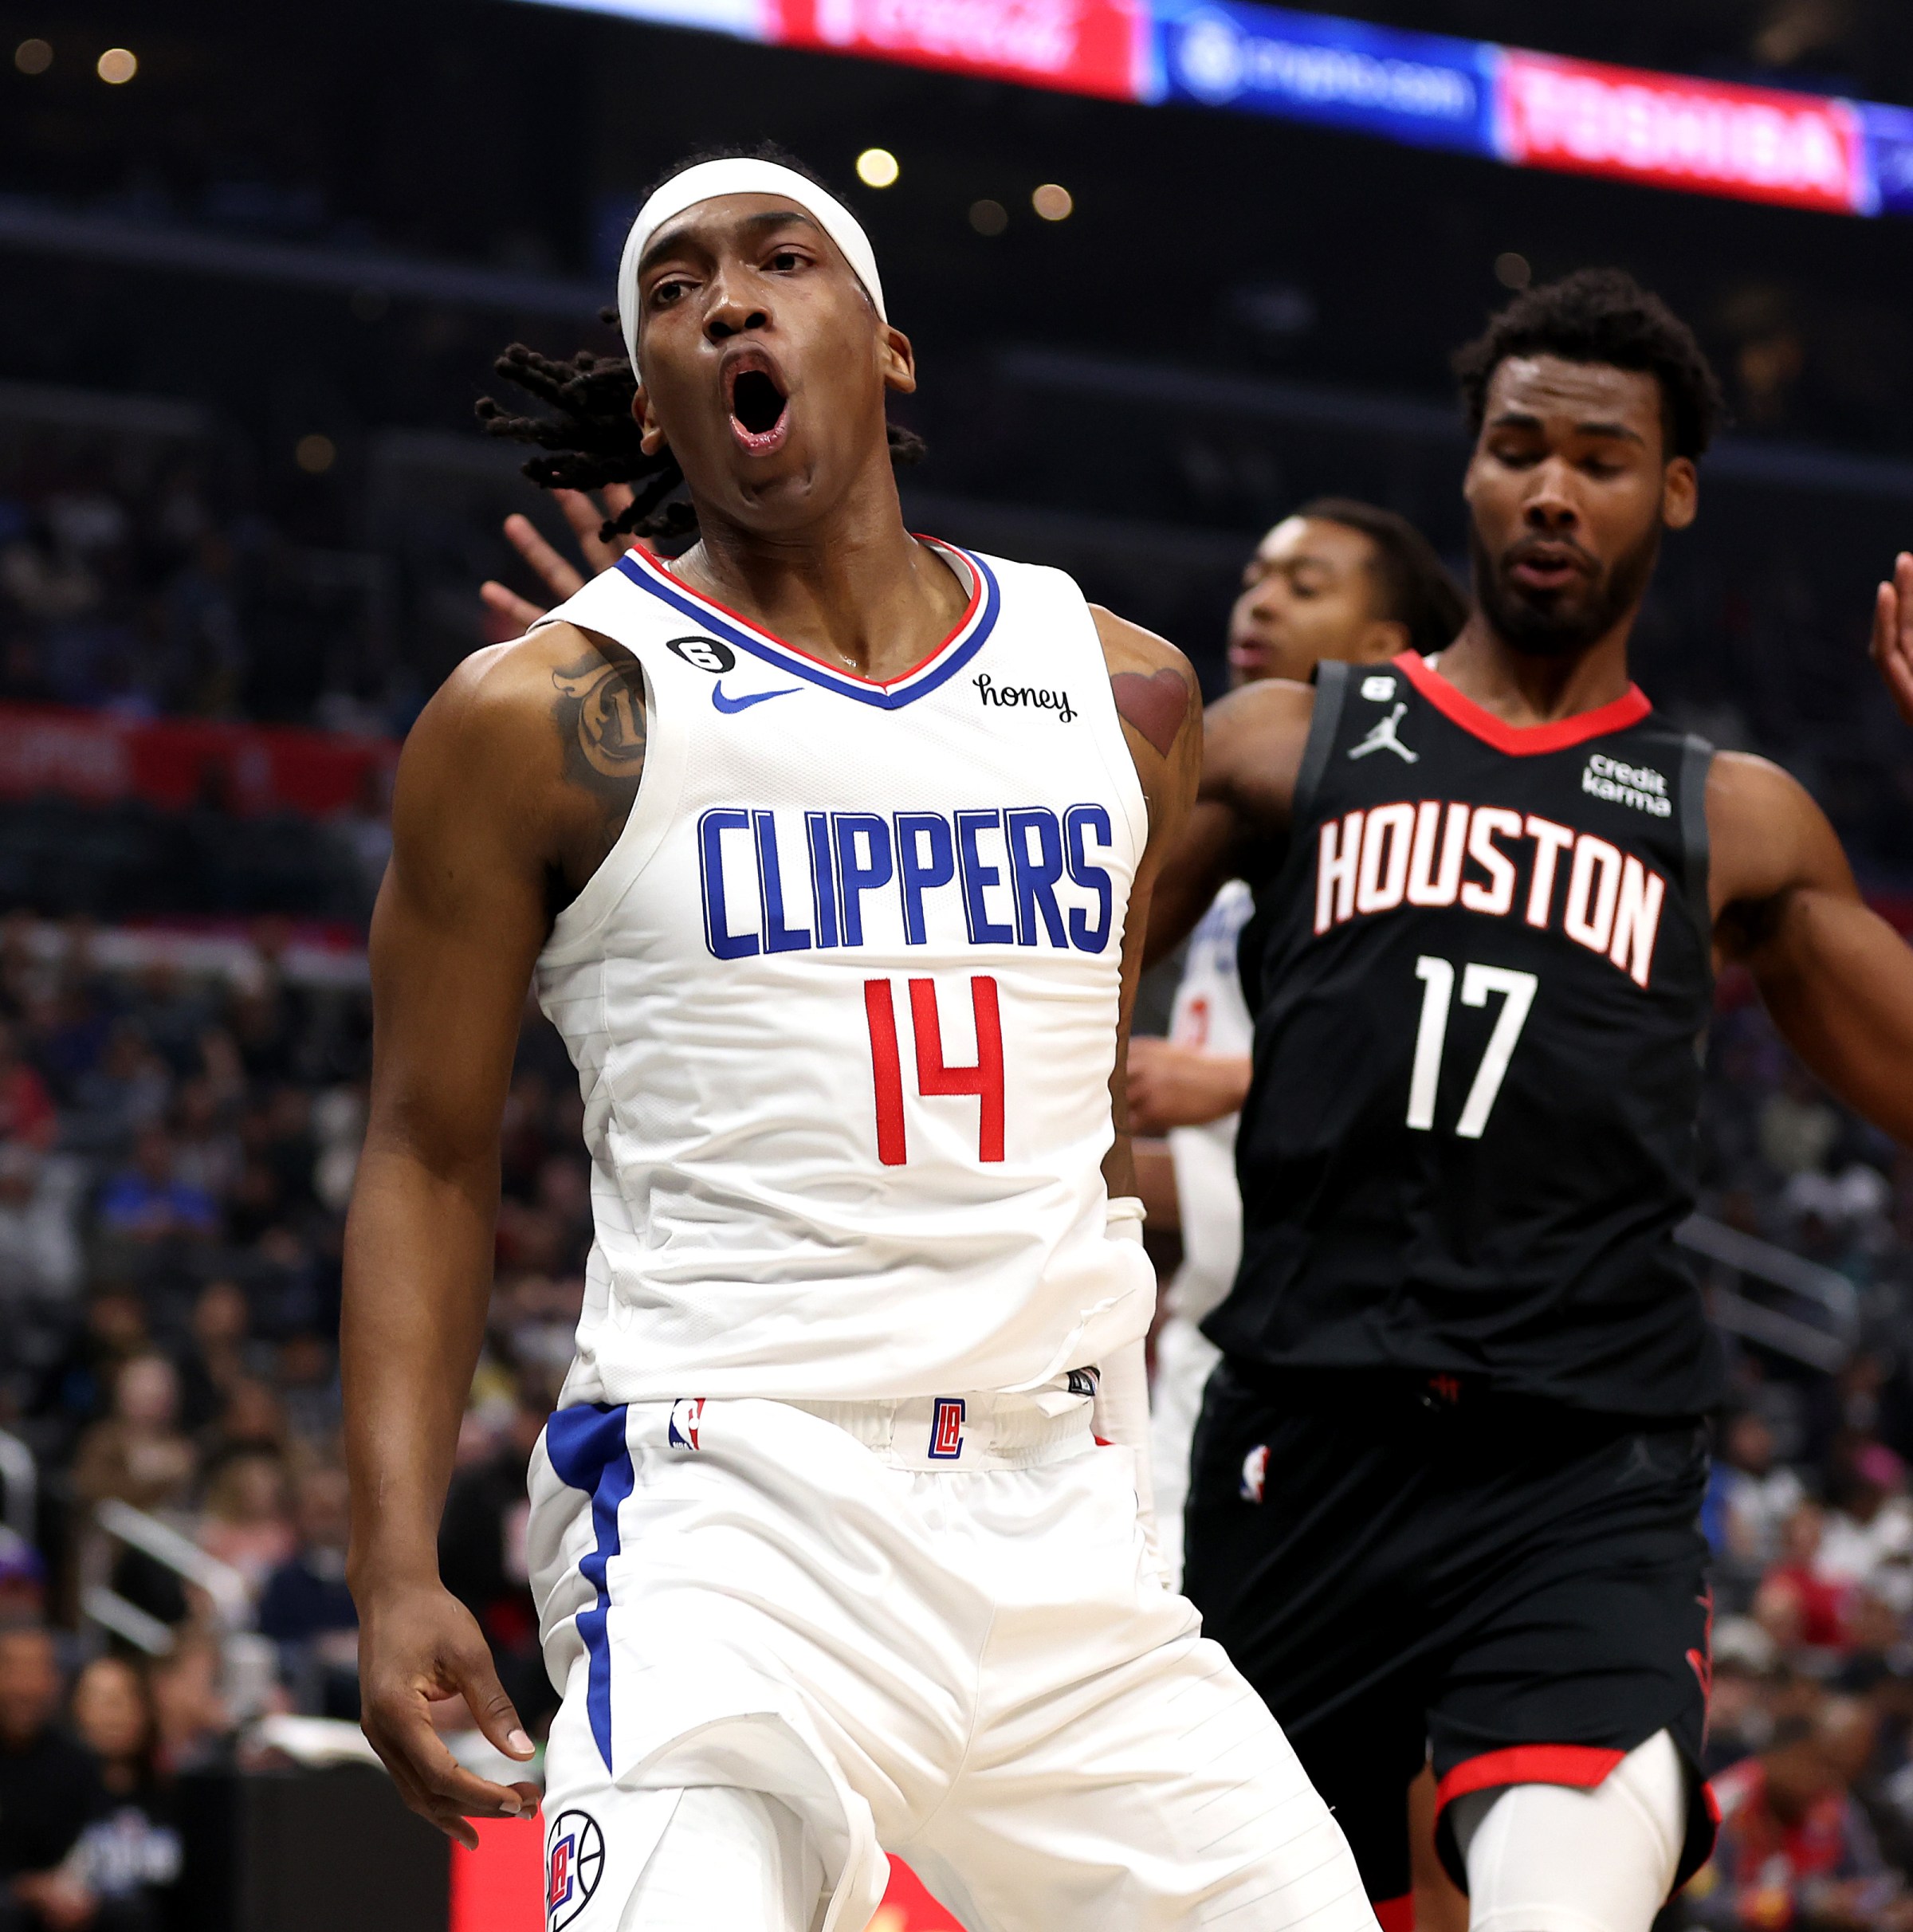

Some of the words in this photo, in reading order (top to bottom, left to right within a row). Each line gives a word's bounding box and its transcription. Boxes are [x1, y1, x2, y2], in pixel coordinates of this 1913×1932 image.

[1513, 65, 1848, 198] TOSHIBA
[678, 641, 725, 670] 6
[972, 673, 1078, 723] honey
[1581, 766, 1672, 818] karma
[1589, 754, 1667, 797] credit
[697, 803, 1112, 960] CLIPPERS
[1314, 799, 1665, 990] HOUSTON
[864, 976, 1005, 1165] 14
[1406, 956, 1538, 1139] 17
